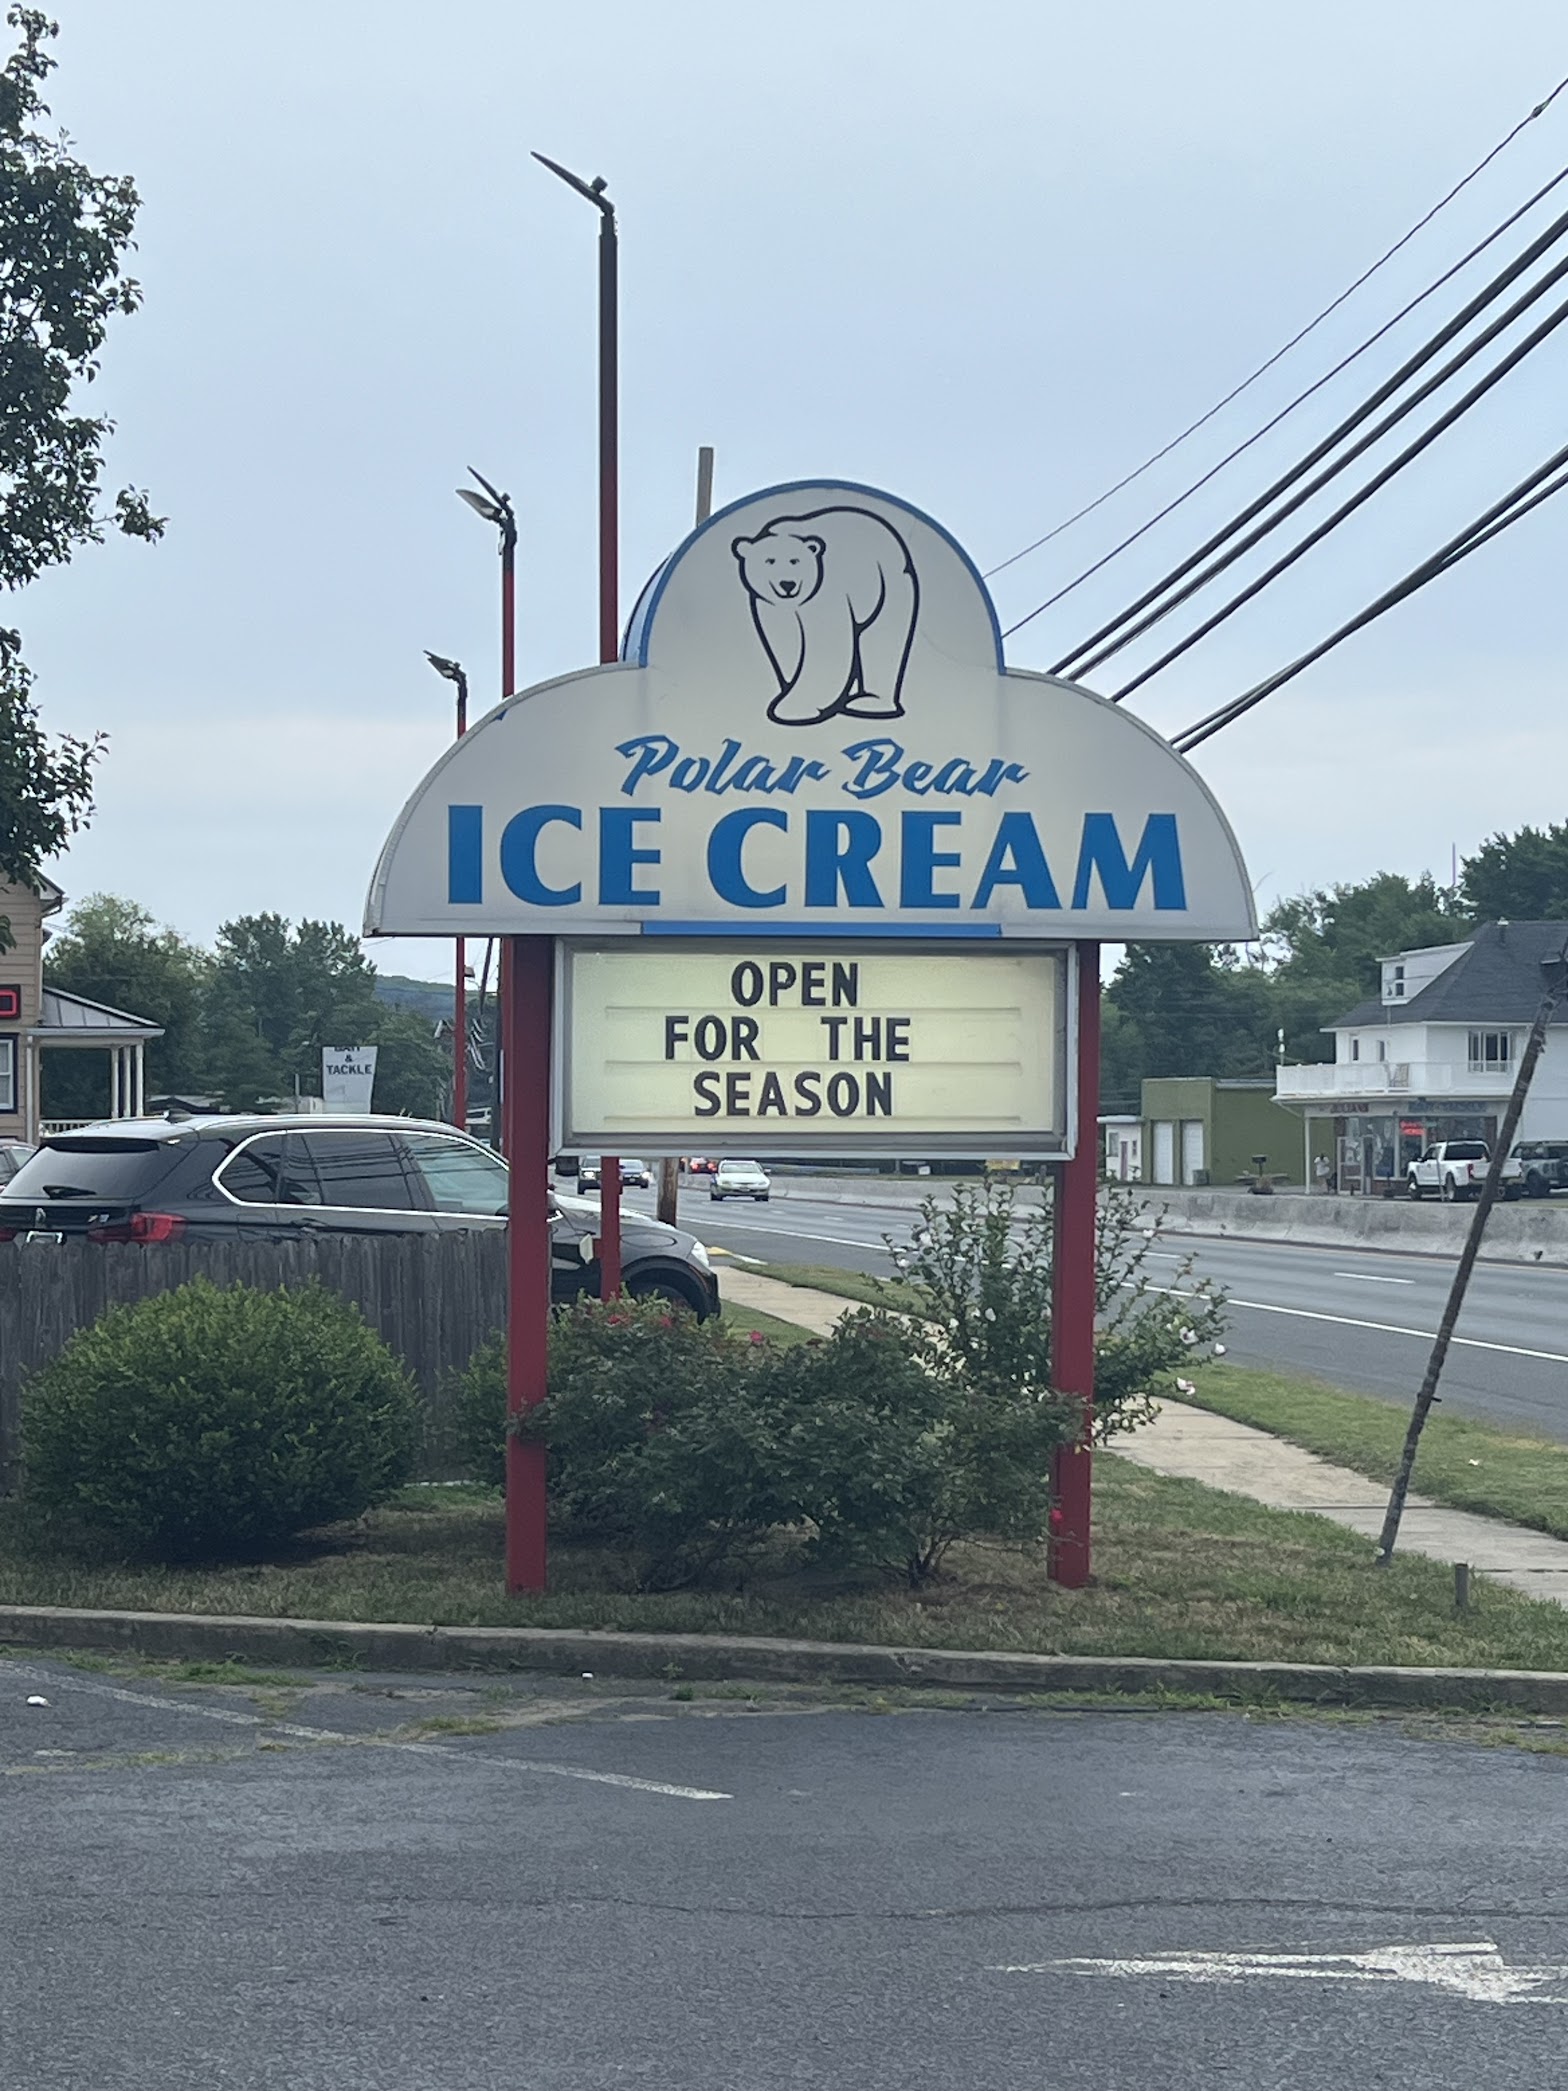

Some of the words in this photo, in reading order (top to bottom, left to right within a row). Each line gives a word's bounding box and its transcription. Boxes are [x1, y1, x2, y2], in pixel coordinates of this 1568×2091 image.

[615, 735, 829, 795] Polar
[842, 737, 1031, 801] Bear
[449, 805, 661, 906] ICE
[709, 808, 1188, 911] CREAM
[731, 961, 859, 1007] OPEN
[345, 1054, 353, 1062] &
[665, 1016, 760, 1061] FOR
[821, 1017, 911, 1061] THE
[326, 1064, 372, 1075] TACKLE
[693, 1072, 892, 1117] SEASON
